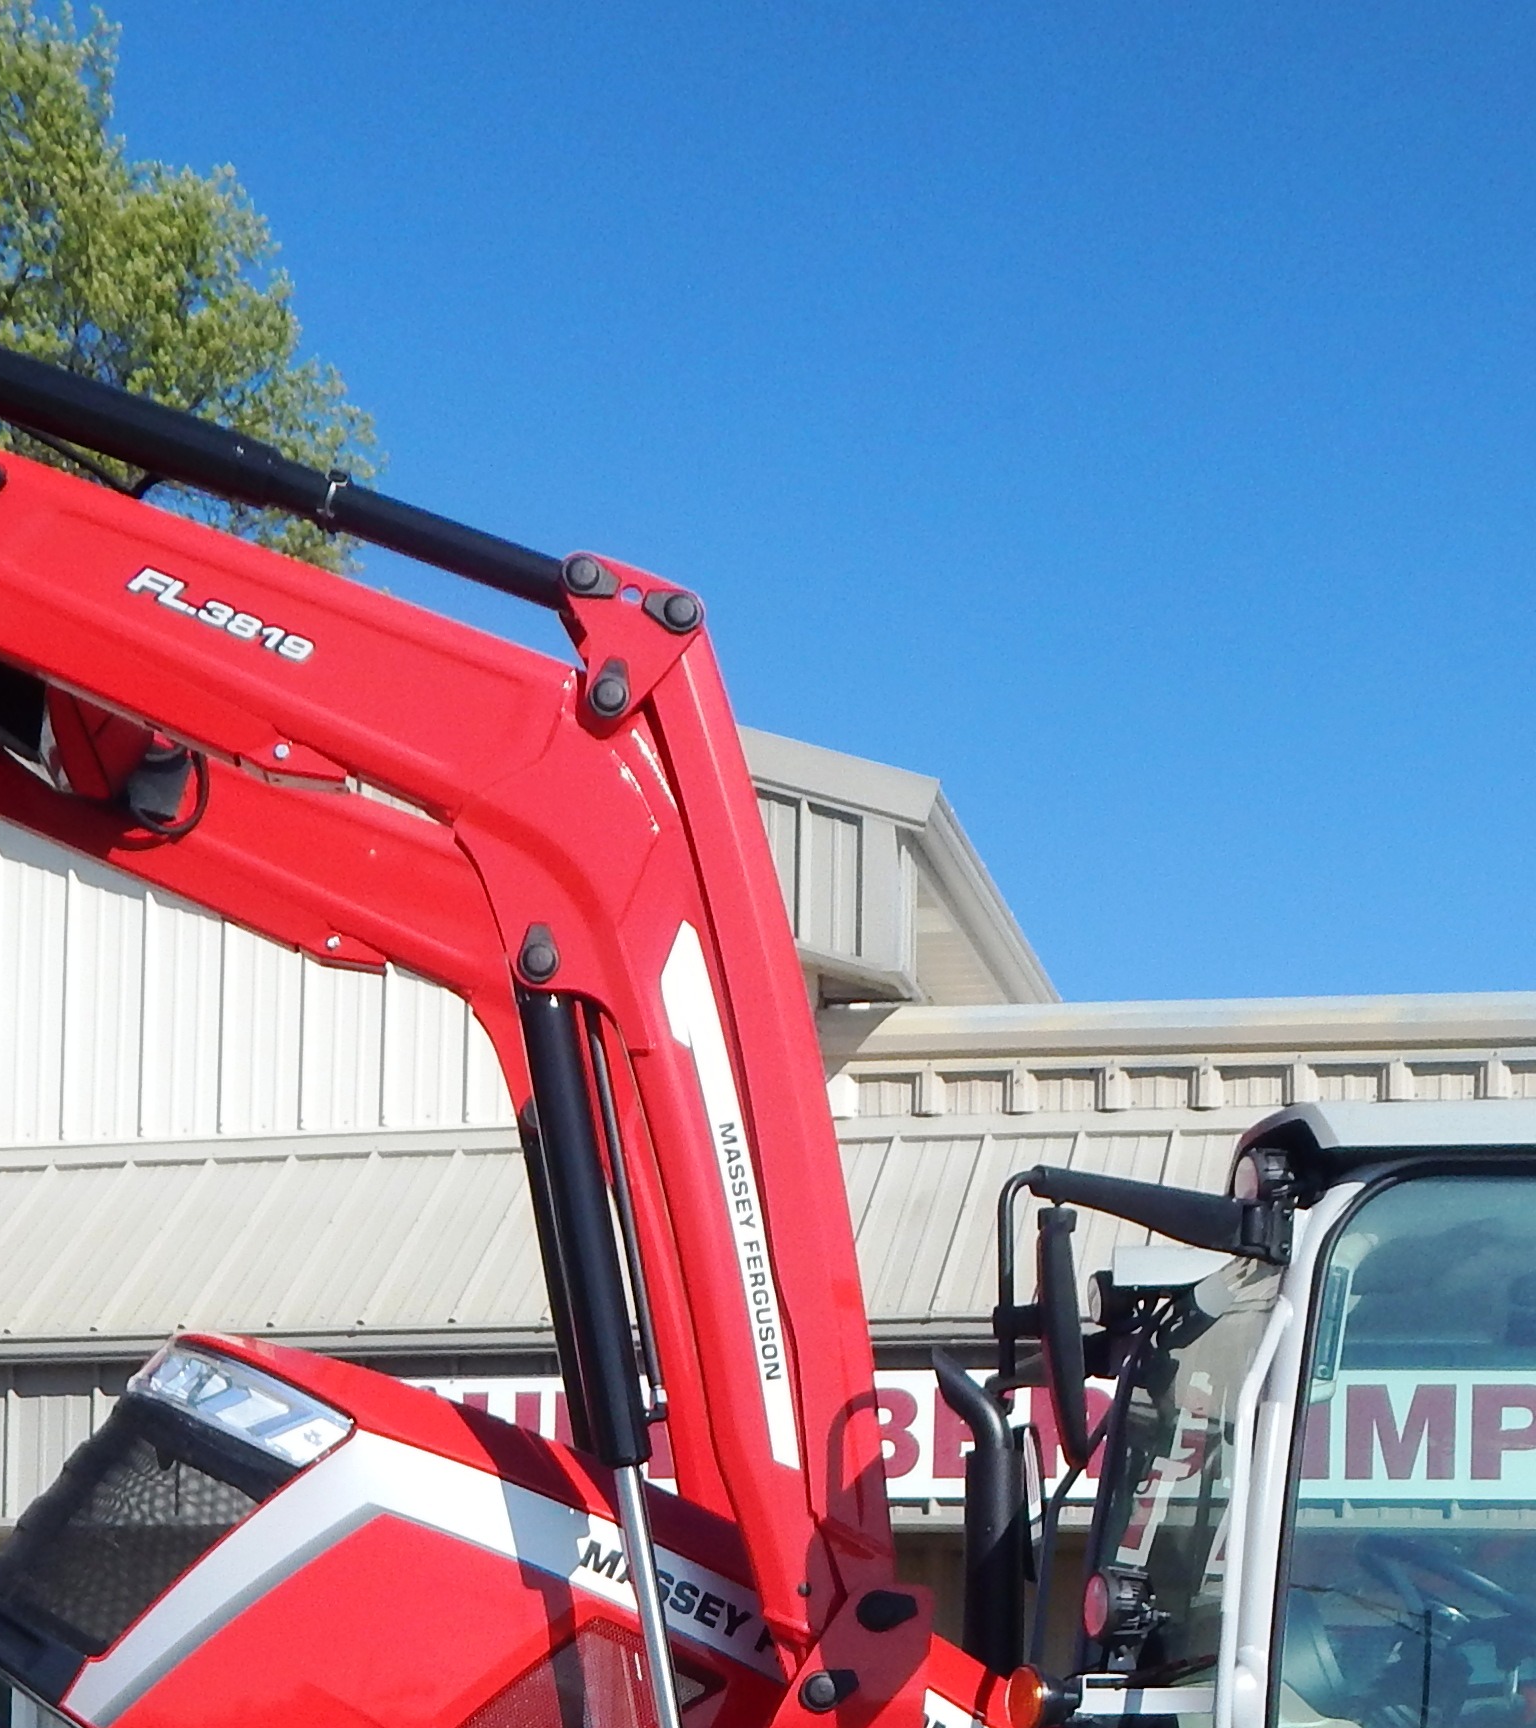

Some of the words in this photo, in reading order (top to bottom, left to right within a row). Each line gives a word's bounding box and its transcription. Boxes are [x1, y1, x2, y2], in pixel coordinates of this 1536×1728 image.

[127, 566, 315, 662] FL.3819
[718, 1121, 756, 1229] MASSEY
[742, 1239, 781, 1381] FERGUSON
